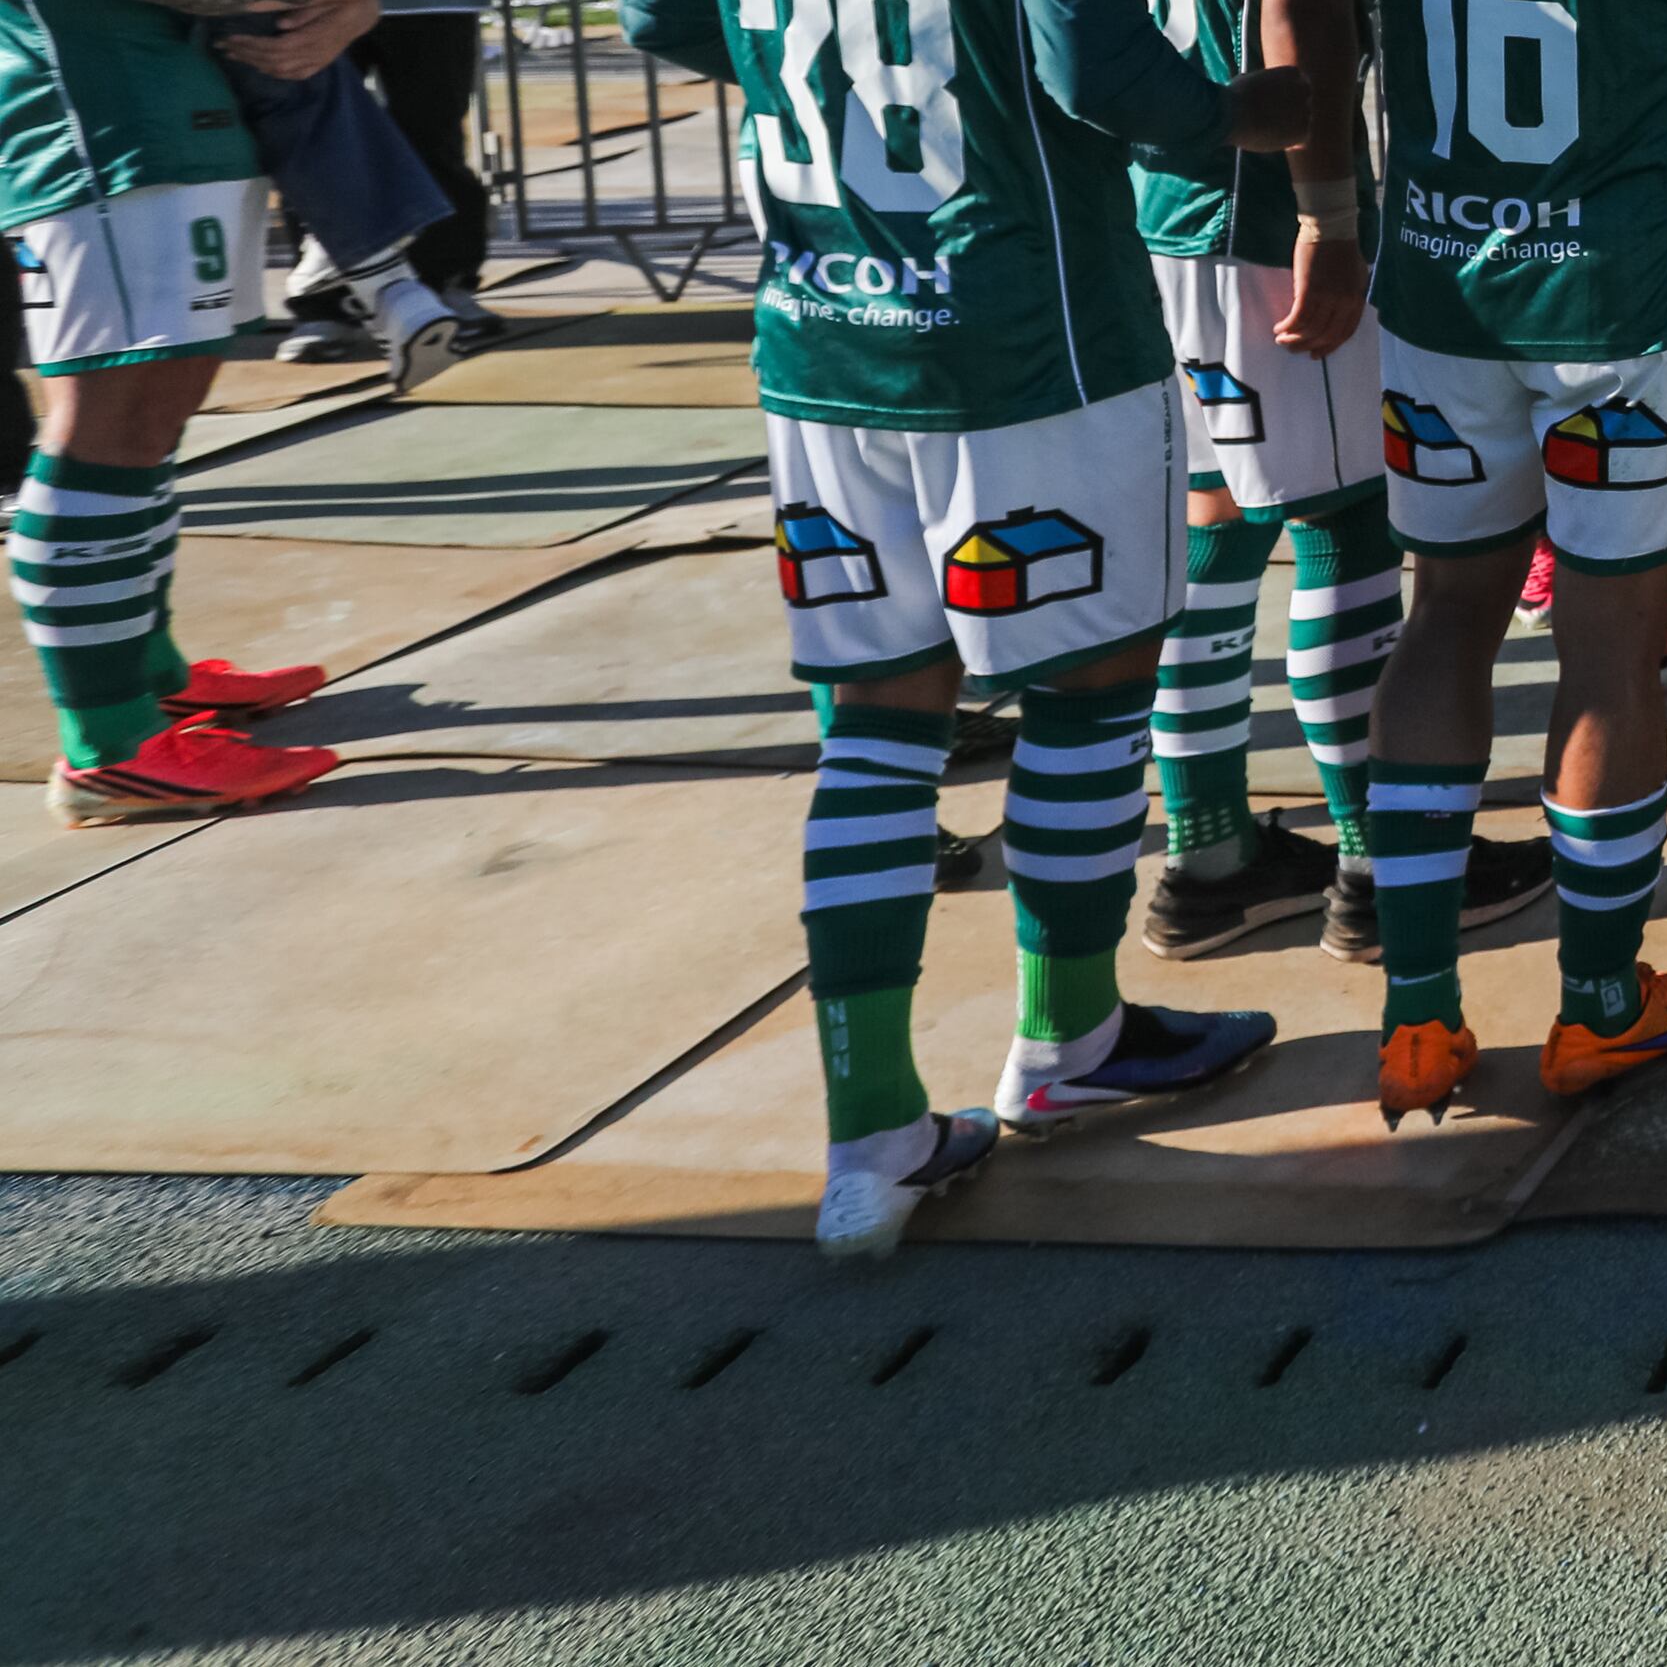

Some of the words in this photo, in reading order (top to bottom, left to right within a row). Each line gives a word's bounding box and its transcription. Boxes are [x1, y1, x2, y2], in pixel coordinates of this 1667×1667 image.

[1405, 178, 1582, 235] RICOH
[189, 215, 227, 283] 9
[1486, 238, 1589, 264] change.
[847, 298, 960, 333] change.
